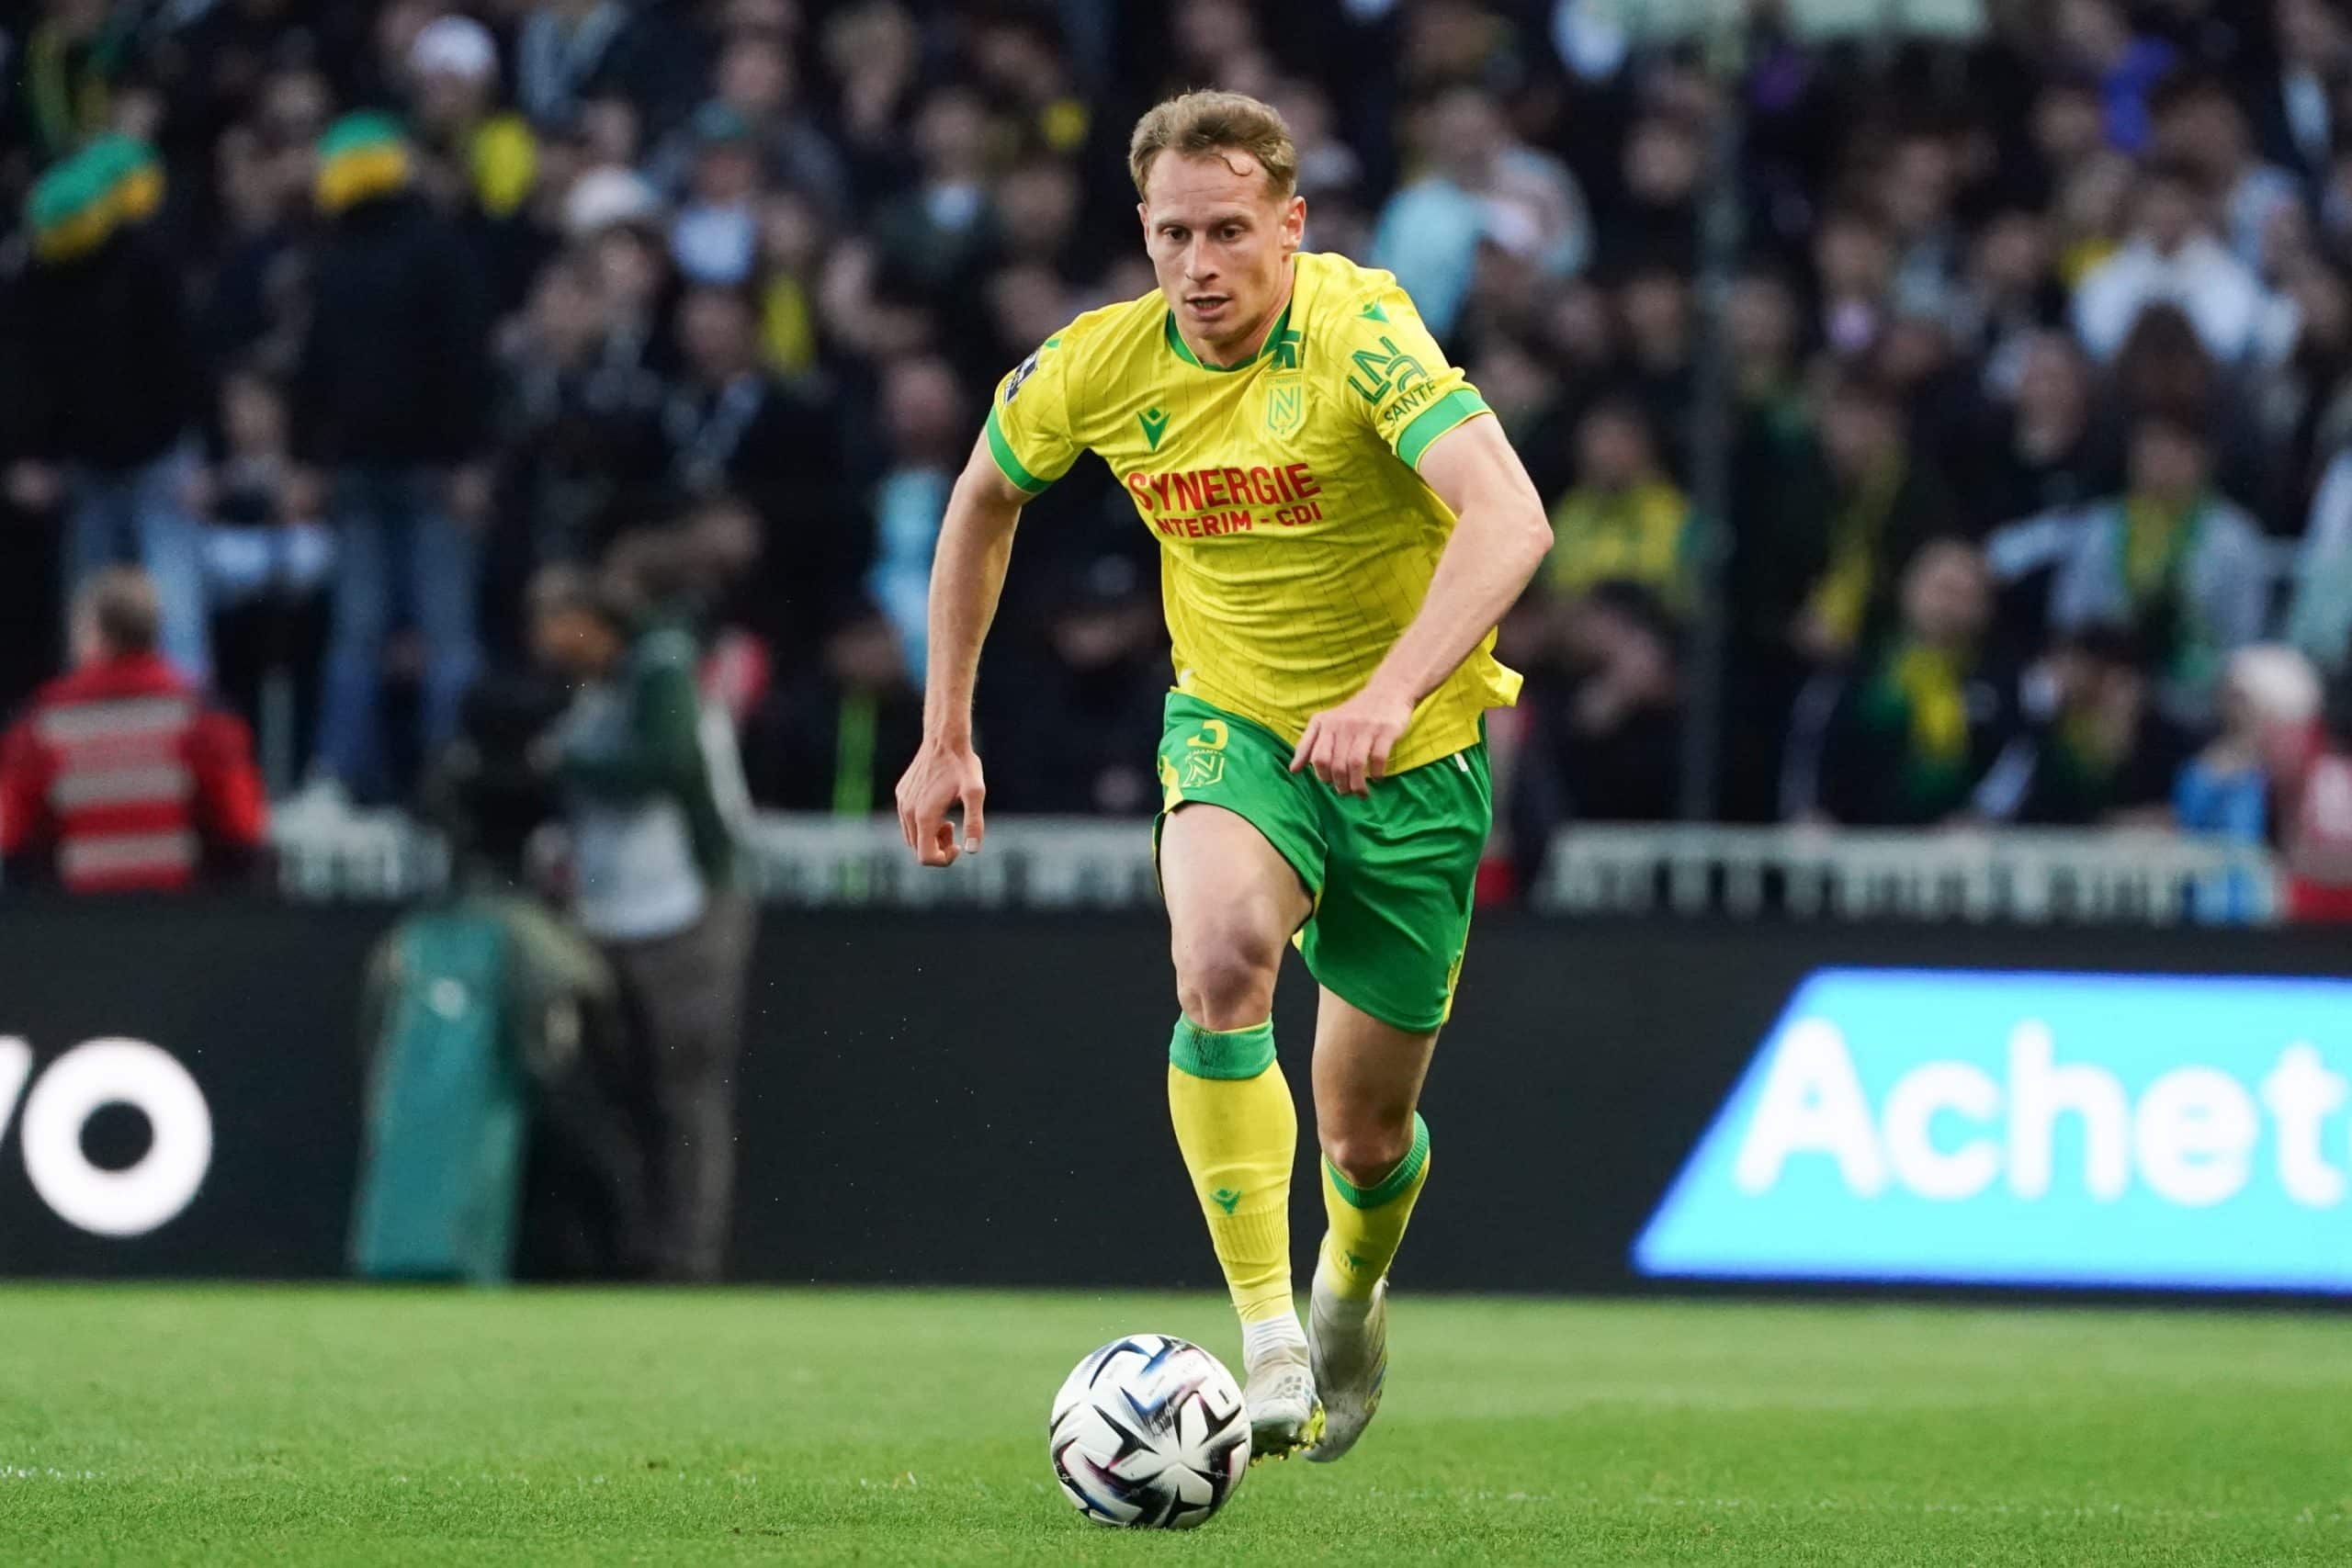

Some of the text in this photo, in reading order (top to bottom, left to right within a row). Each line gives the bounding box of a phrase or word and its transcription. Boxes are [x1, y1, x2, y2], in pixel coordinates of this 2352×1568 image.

[1128, 463, 1321, 512] SYNERGIE
[1155, 510, 1252, 538] NTERIM
[1275, 502, 1323, 527] CDI
[1733, 1014, 2352, 1210] Achet
